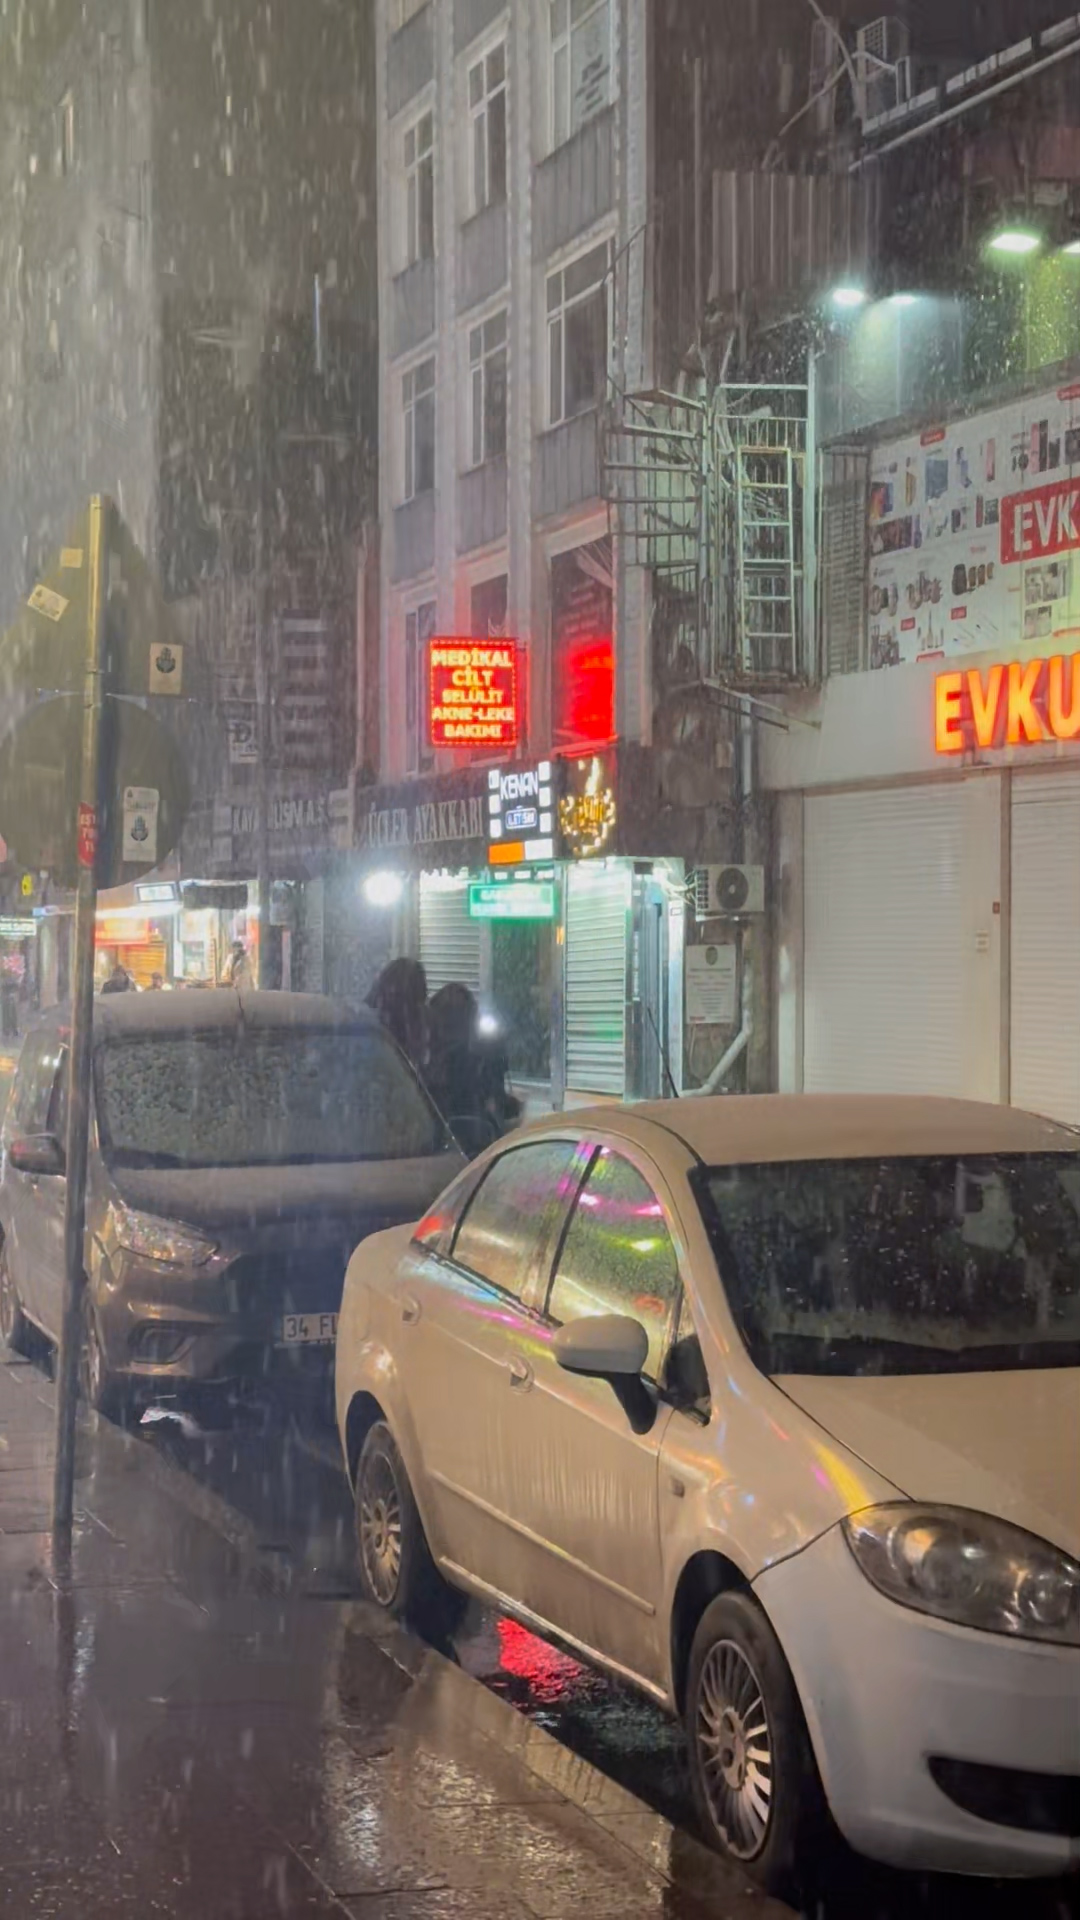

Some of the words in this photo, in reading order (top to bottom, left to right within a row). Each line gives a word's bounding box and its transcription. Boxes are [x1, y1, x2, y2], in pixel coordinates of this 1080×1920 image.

[1013, 490, 1079, 554] EVK
[431, 648, 513, 667] MEDİKAL
[451, 665, 494, 687] CİLT
[935, 652, 1080, 753] EVKU
[444, 724, 502, 738] BAKIMI
[500, 771, 539, 801] KENAN
[413, 796, 484, 844] AYAKKABI
[286, 1317, 308, 1338] 34
